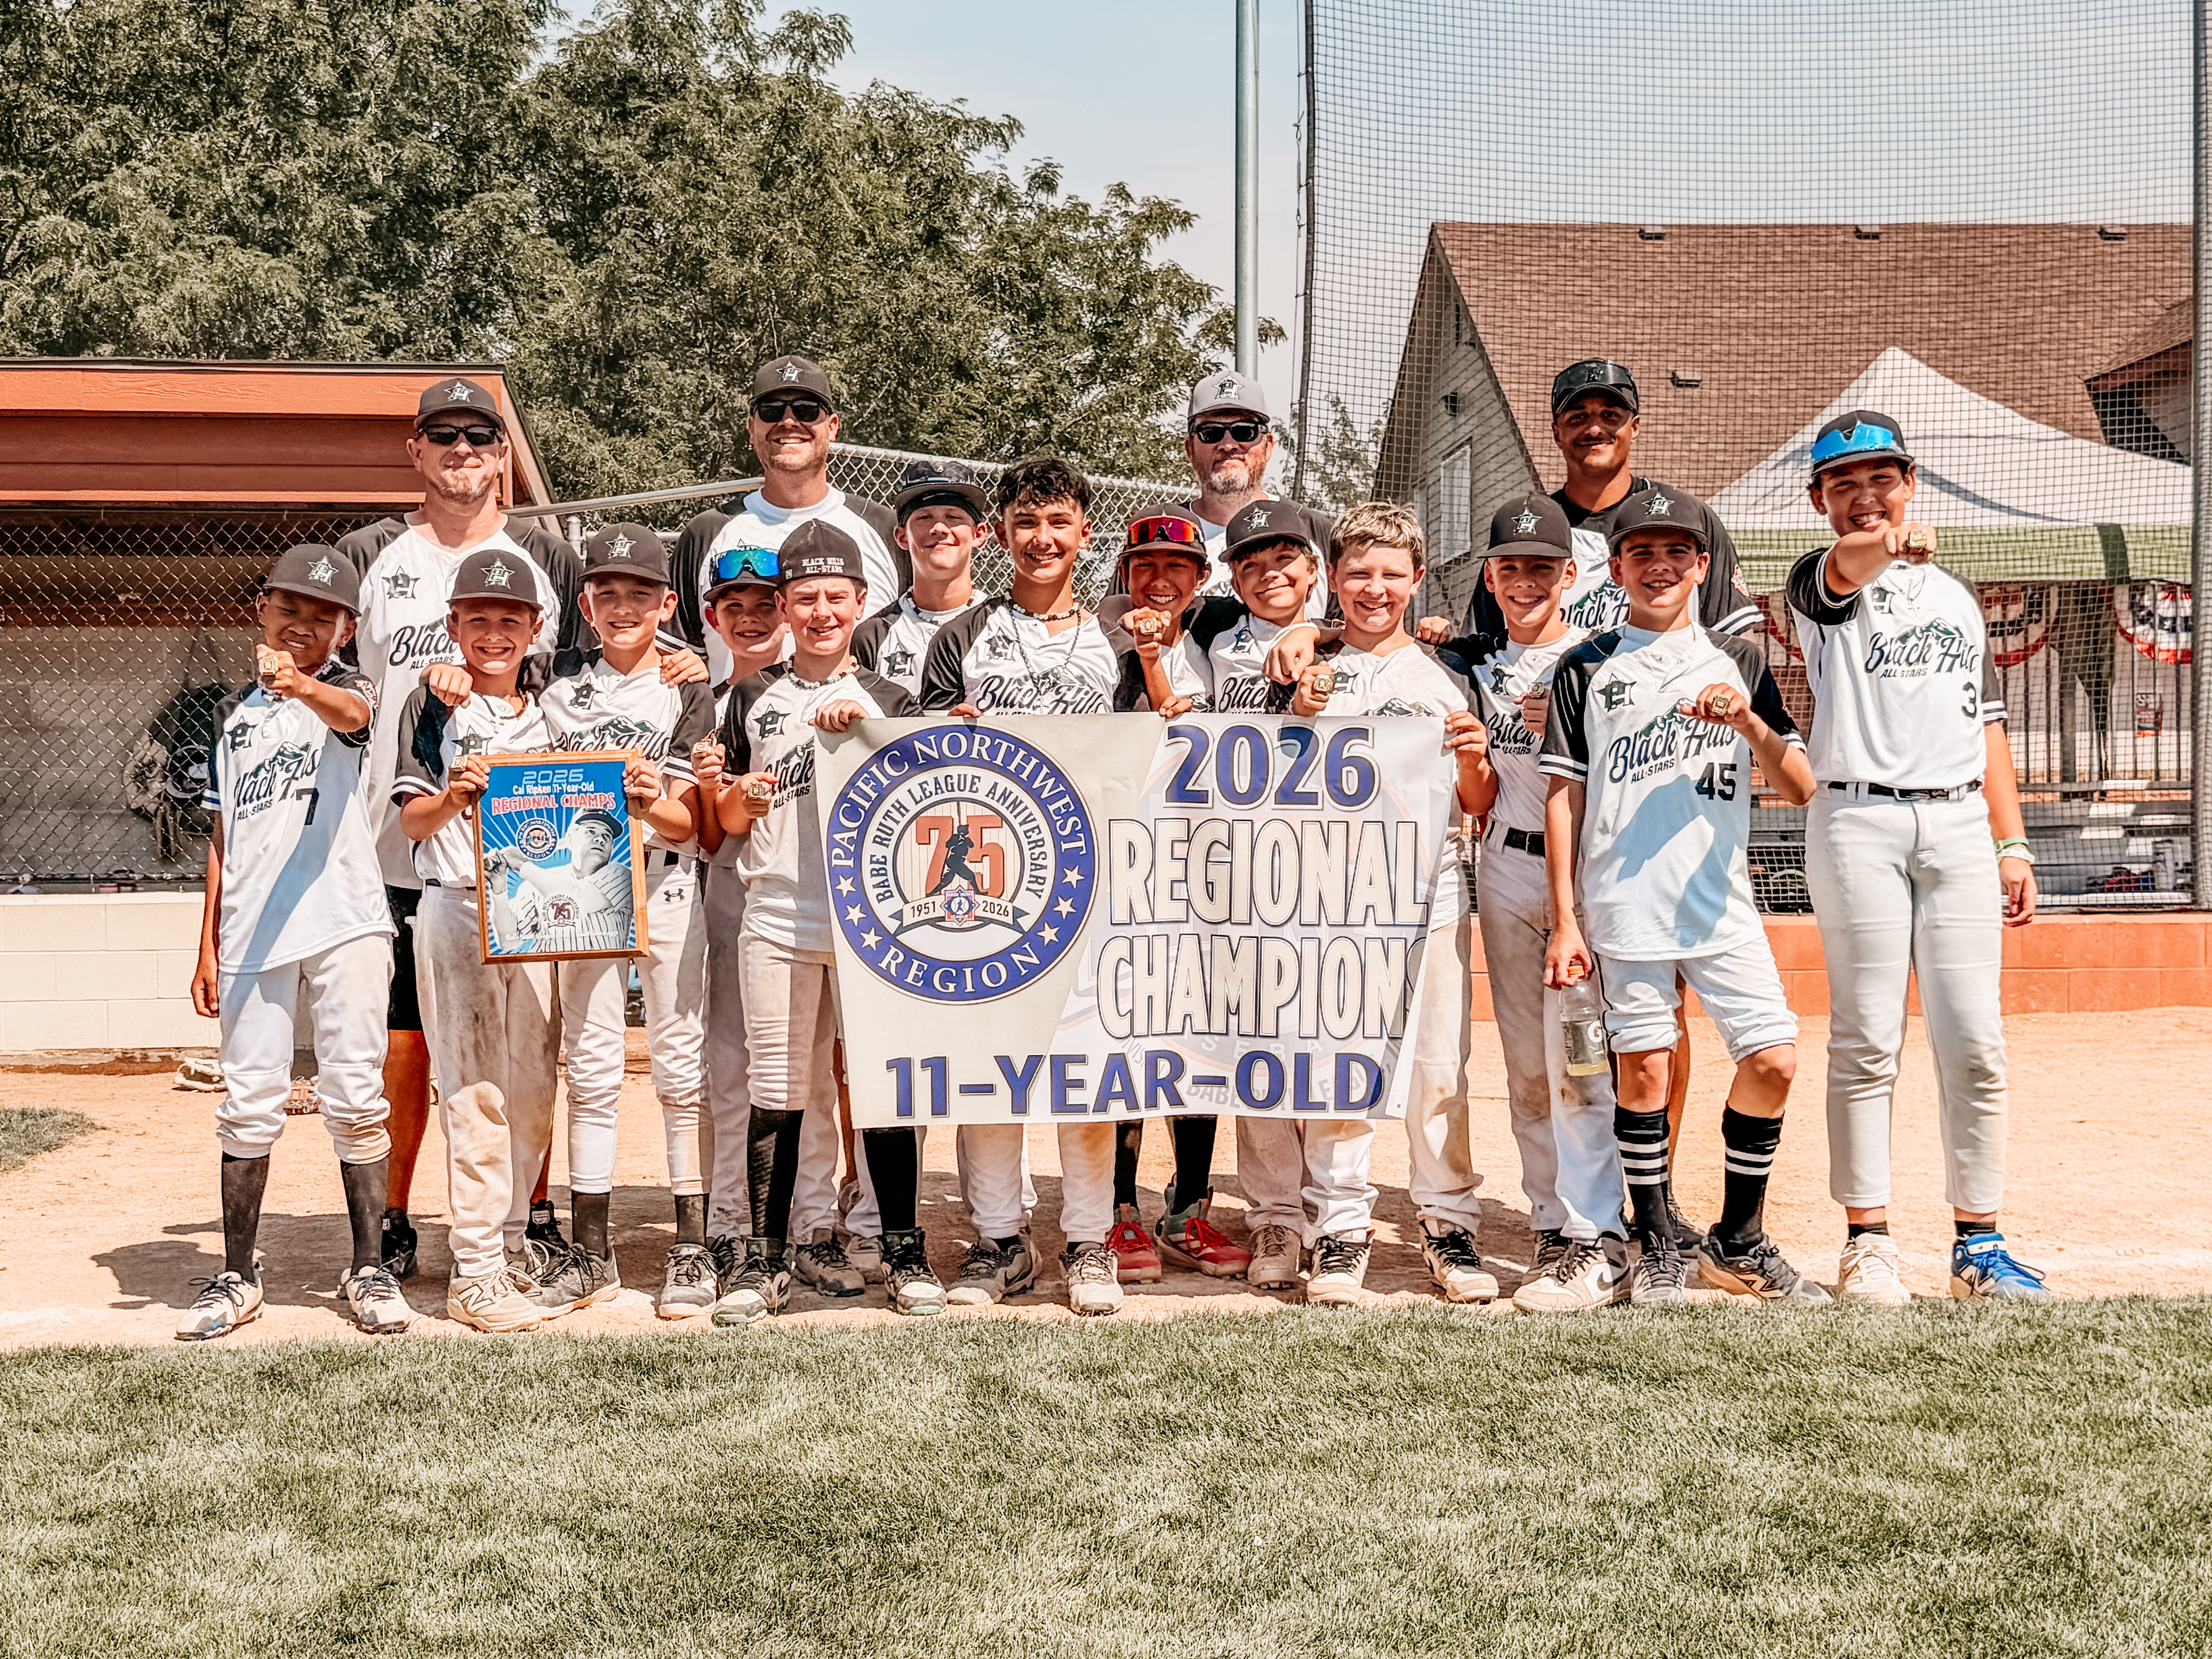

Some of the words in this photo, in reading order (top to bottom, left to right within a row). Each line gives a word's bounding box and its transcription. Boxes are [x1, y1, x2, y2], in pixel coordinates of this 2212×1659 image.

[1560, 594, 1607, 628] lack
[1864, 631, 1933, 674] Black
[1880, 668, 1928, 679] ALL-STARS
[1219, 677, 1267, 713] Blac
[1961, 681, 1977, 720] 3
[1163, 723, 1380, 811] 2026
[1608, 719, 1678, 783] Black
[513, 785, 525, 795] Cal
[522, 768, 584, 784] 2026
[764, 749, 815, 796] lack
[907, 774, 982, 805] LEAGUE
[1631, 758, 1675, 784] ALL-STARS
[1695, 762, 1737, 801] 45
[237, 799, 273, 822] ALL-STARS
[296, 788, 320, 825] 7
[492, 795, 559, 816] REGIONAL
[560, 792, 616, 810] CHAMPS
[773, 785, 811, 810] ALL-STARS
[831, 750, 909, 868] PACIFIC
[913, 732, 1087, 855] NORTHWEST
[872, 798, 910, 849] RUTH
[985, 781, 1048, 899] ANNIVERSARY
[916, 815, 1005, 899] 75
[1108, 818, 1429, 926] REGIONAL
[869, 854, 895, 904] BABE
[911, 901, 936, 918] 1951
[982, 900, 1009, 917] 2026
[878, 942, 1041, 993] REGION
[886, 1049, 1384, 1118] 11-YEAR-OLD
